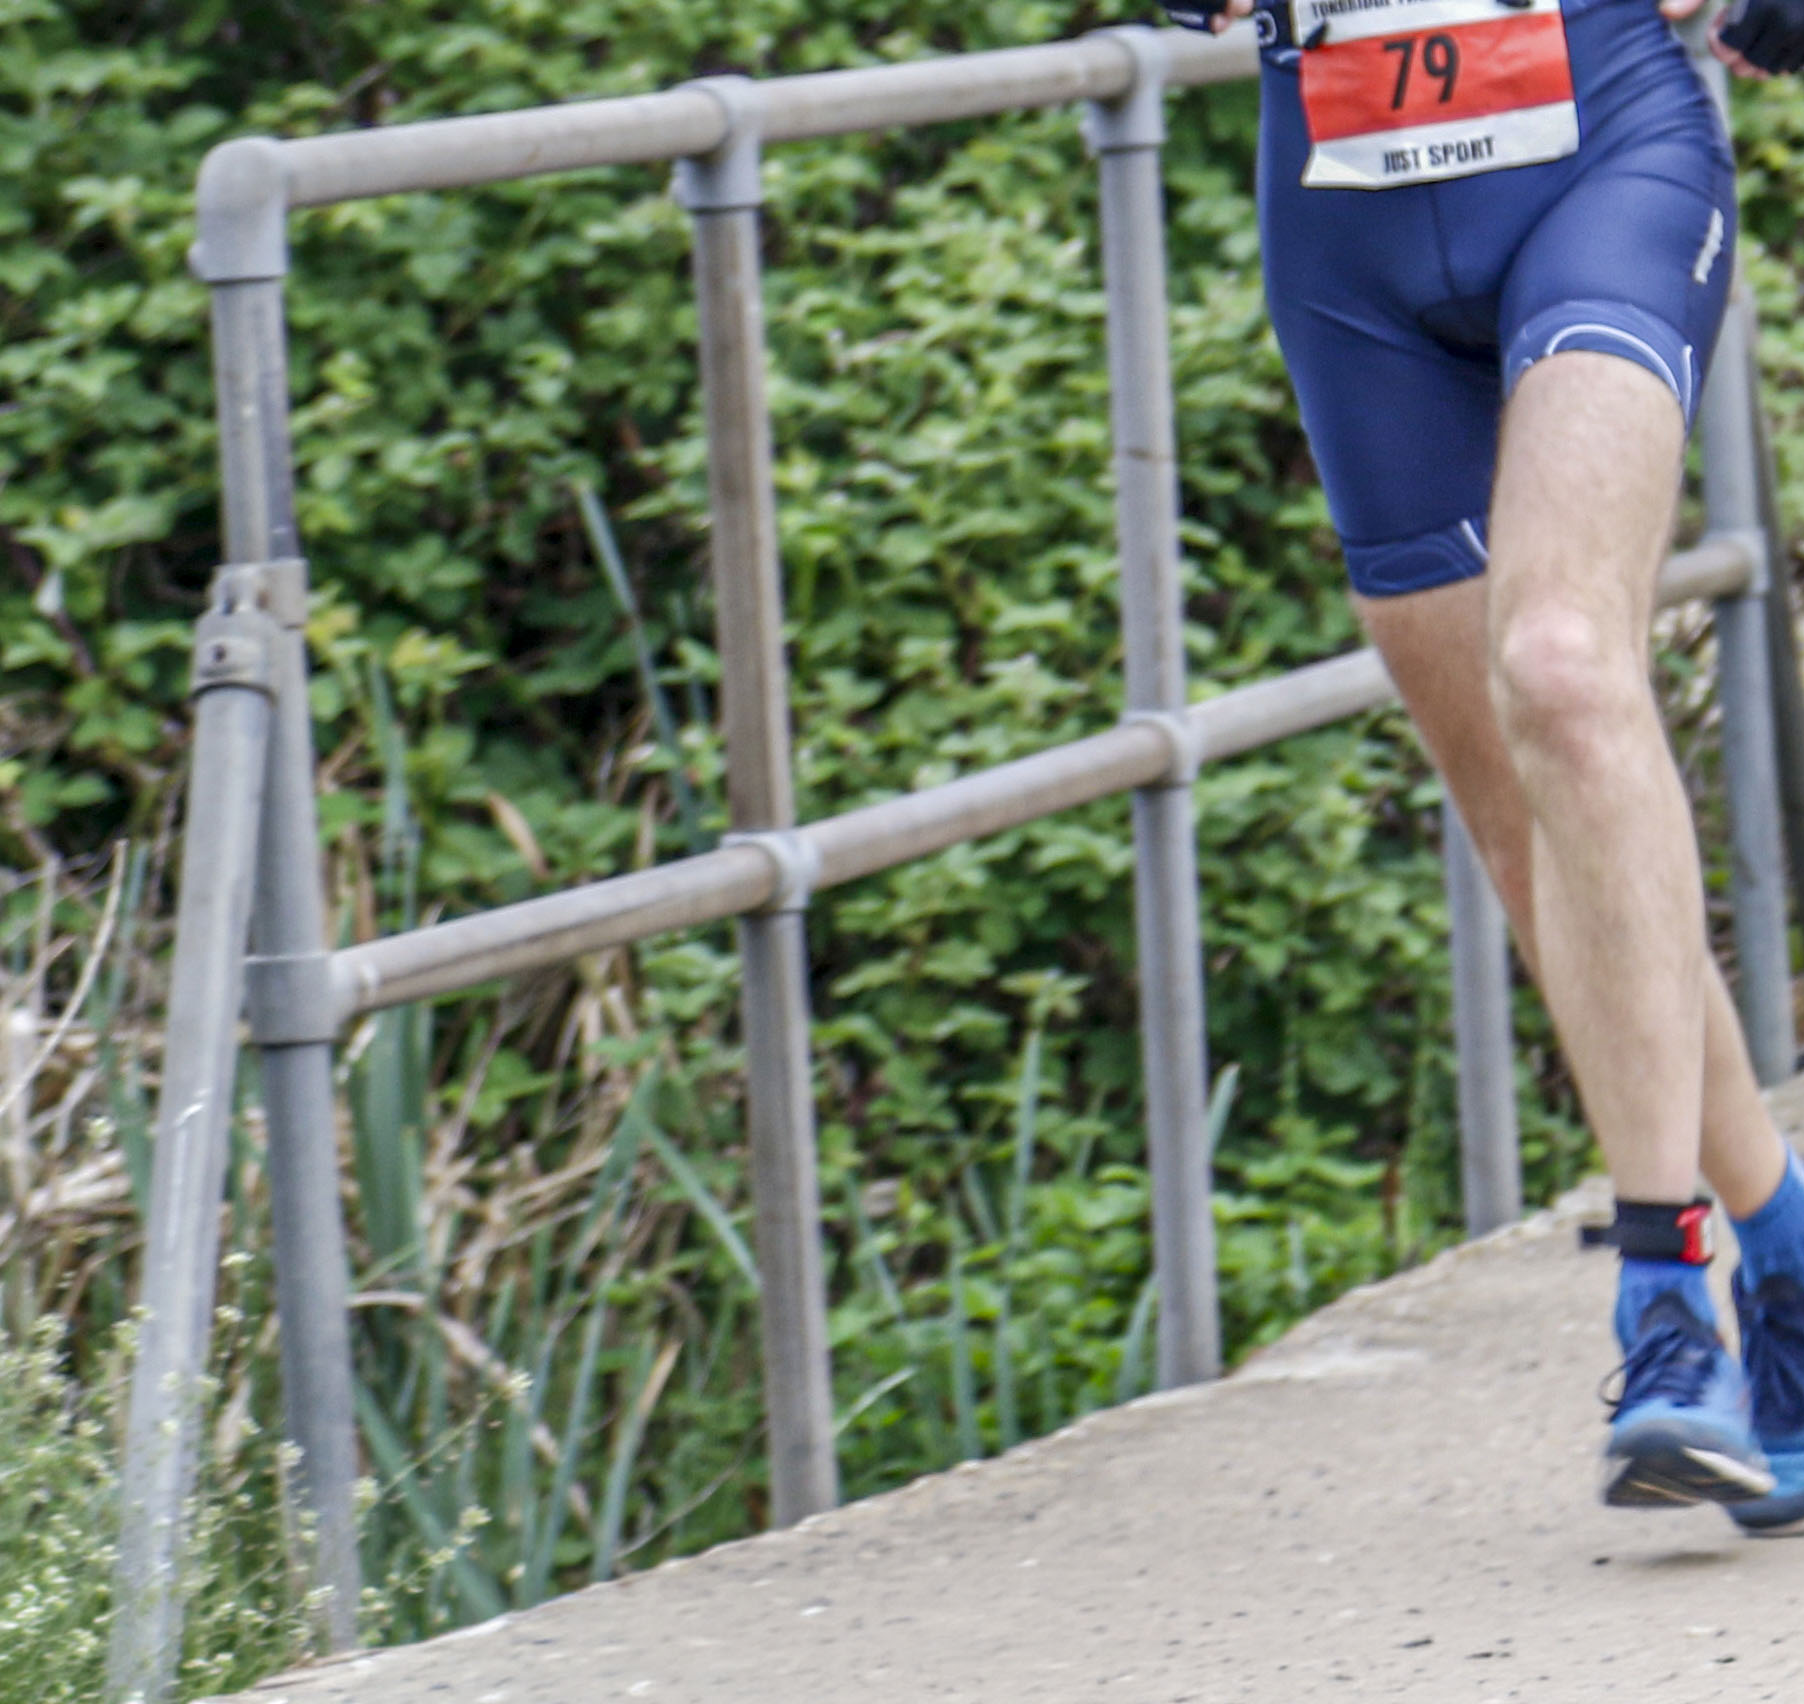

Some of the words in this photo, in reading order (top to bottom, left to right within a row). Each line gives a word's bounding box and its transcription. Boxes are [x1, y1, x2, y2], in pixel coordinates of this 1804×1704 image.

[1384, 34, 1460, 111] 79
[1383, 146, 1422, 174] JUST
[1428, 135, 1496, 167] SPORT
